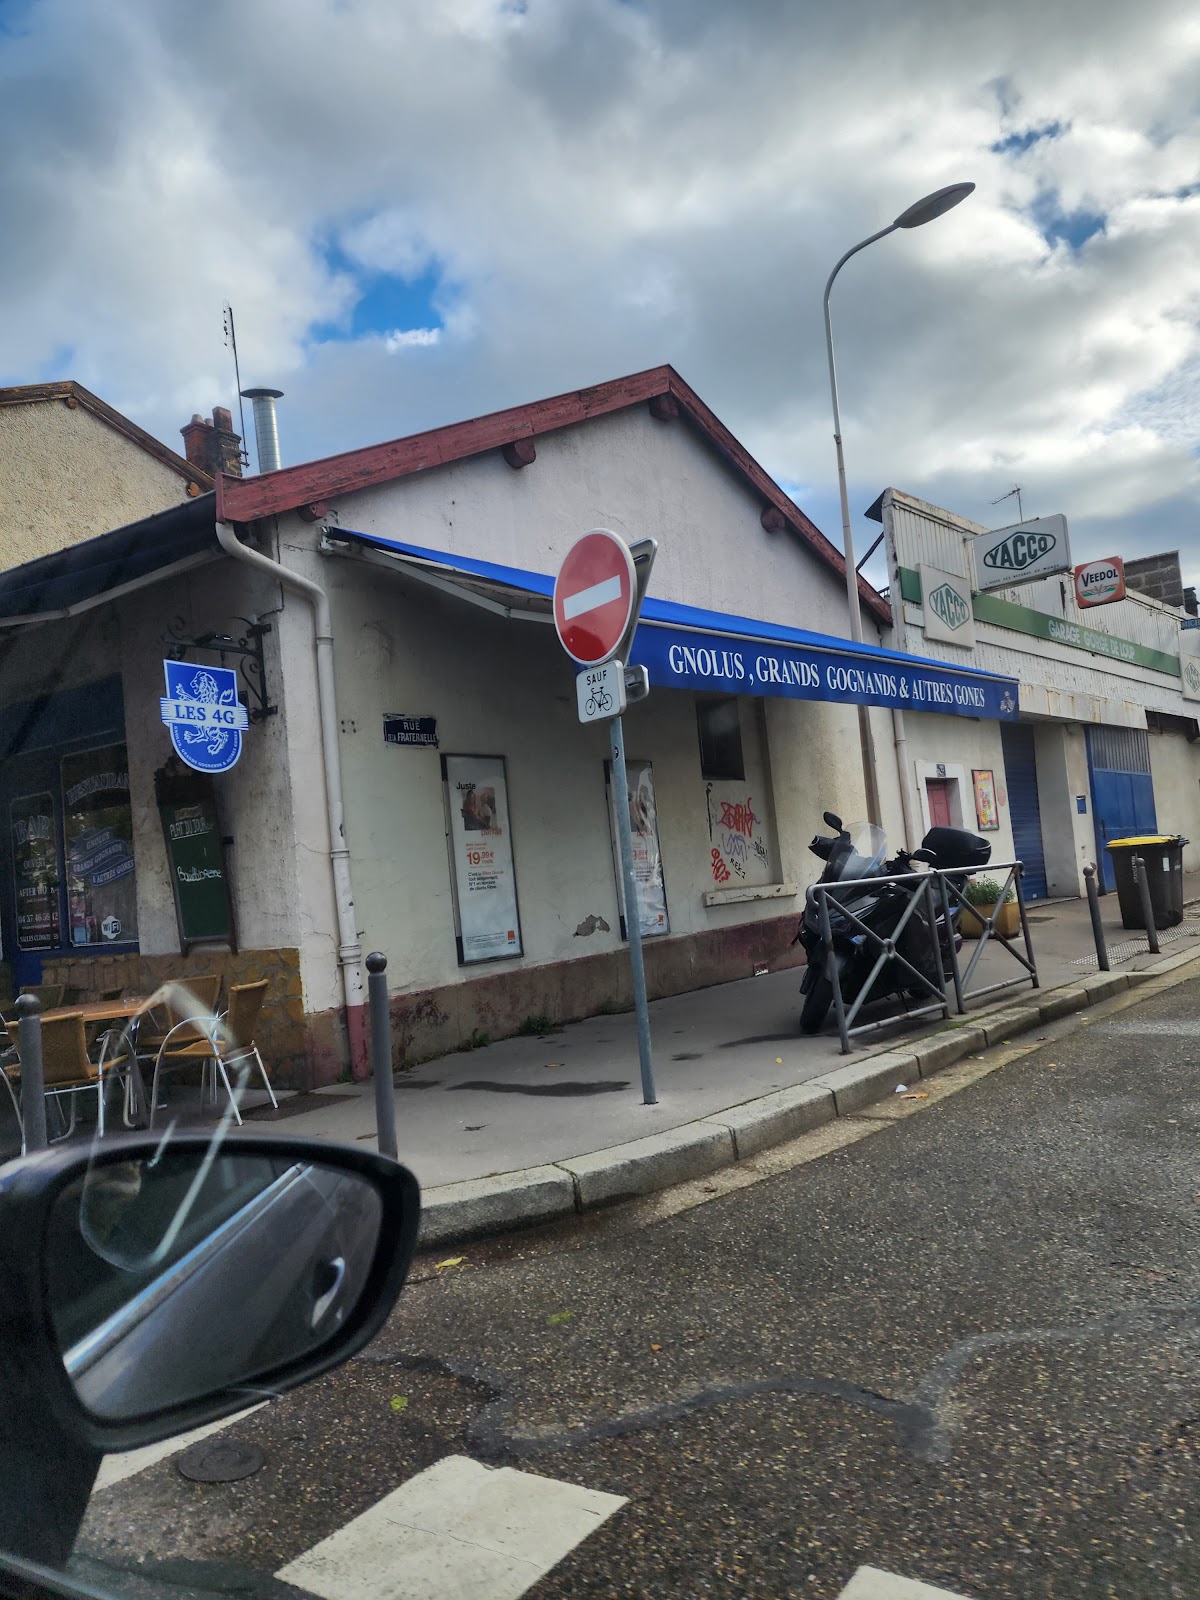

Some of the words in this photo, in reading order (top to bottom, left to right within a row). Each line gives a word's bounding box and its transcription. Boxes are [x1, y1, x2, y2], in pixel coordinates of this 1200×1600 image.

[988, 534, 1048, 568] YACCO
[1081, 568, 1119, 588] VEEDOL
[932, 586, 966, 628] YACCO
[1048, 619, 1080, 644] GARAGE
[1083, 631, 1109, 651] GORGE
[1110, 638, 1119, 656] DE
[1119, 641, 1135, 660] LOUP
[586, 669, 607, 686] SAUF
[826, 665, 897, 698] GOGNANDS
[899, 676, 910, 699] &
[912, 678, 953, 704] AUTRES
[954, 684, 985, 708] GONES
[174, 704, 206, 721] LES
[212, 709, 235, 725] 4G
[403, 721, 421, 731] RUE
[397, 732, 437, 743] FRATERNELLE
[456, 782, 476, 790] Juste
[14, 815, 51, 846] BAR
[96, 869, 116, 883] AUTRES
[116, 859, 135, 875] GONES
